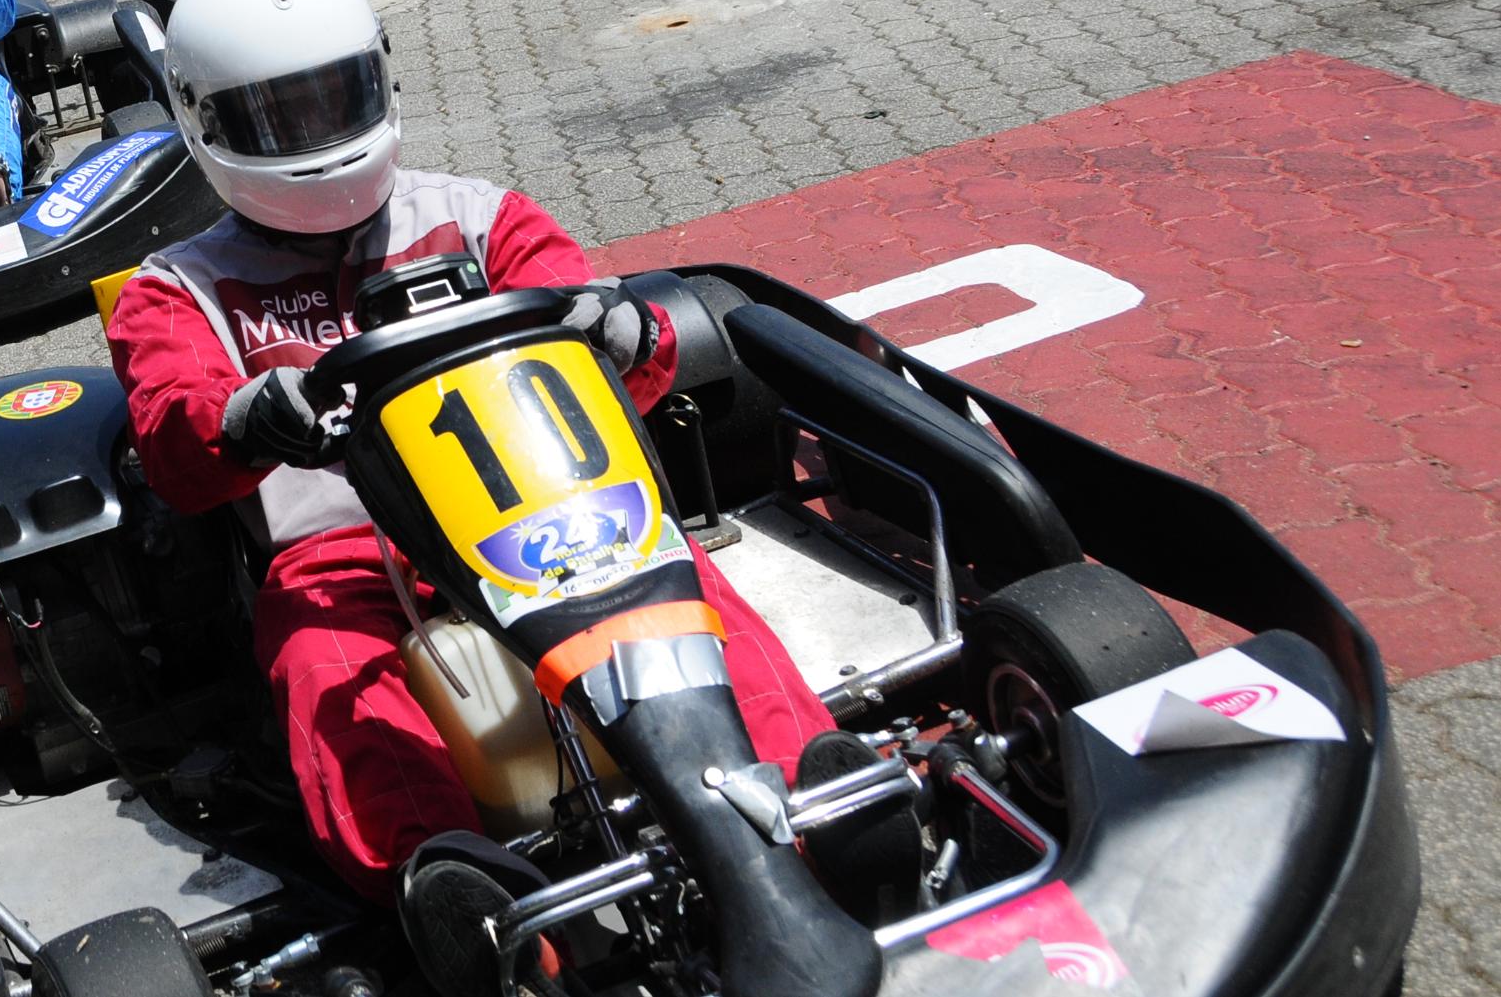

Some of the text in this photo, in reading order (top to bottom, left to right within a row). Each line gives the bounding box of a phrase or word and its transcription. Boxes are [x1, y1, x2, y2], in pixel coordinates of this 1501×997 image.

[81, 172, 116, 204] INDUSTRIA
[110, 161, 124, 173] DE
[429, 358, 611, 515] 10
[554, 541, 592, 561] hora
[544, 564, 565, 580] da
